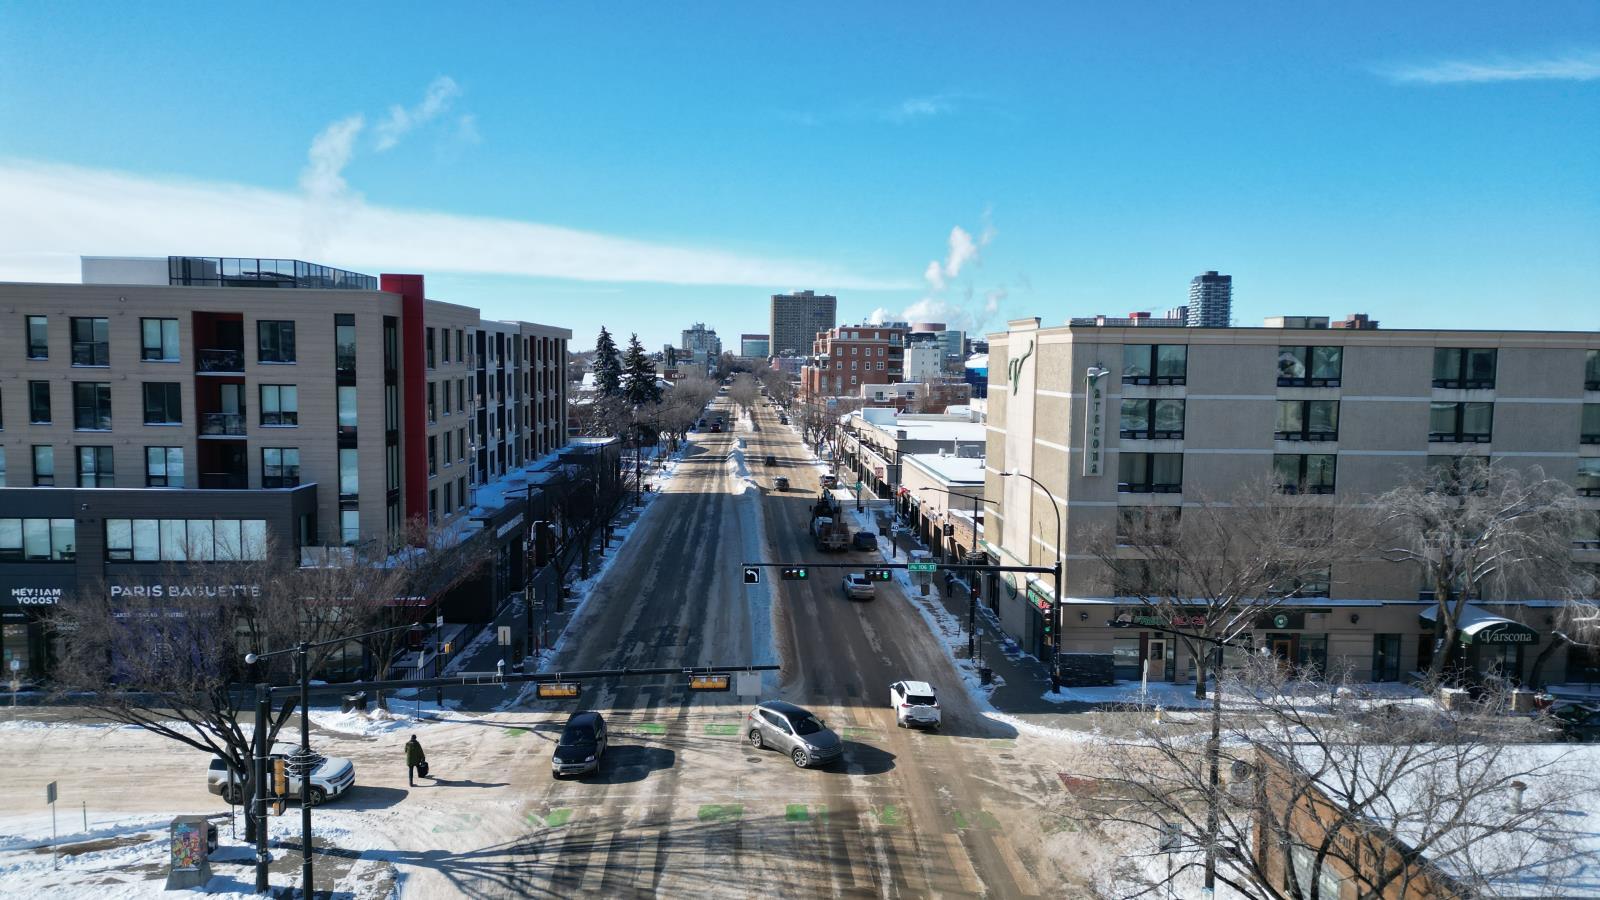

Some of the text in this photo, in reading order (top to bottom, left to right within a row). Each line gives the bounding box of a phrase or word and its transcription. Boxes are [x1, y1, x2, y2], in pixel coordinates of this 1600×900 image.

[110, 584, 163, 597] PARIS
[16, 597, 60, 605] YOGOST
[1480, 623, 1532, 643] Varscona
